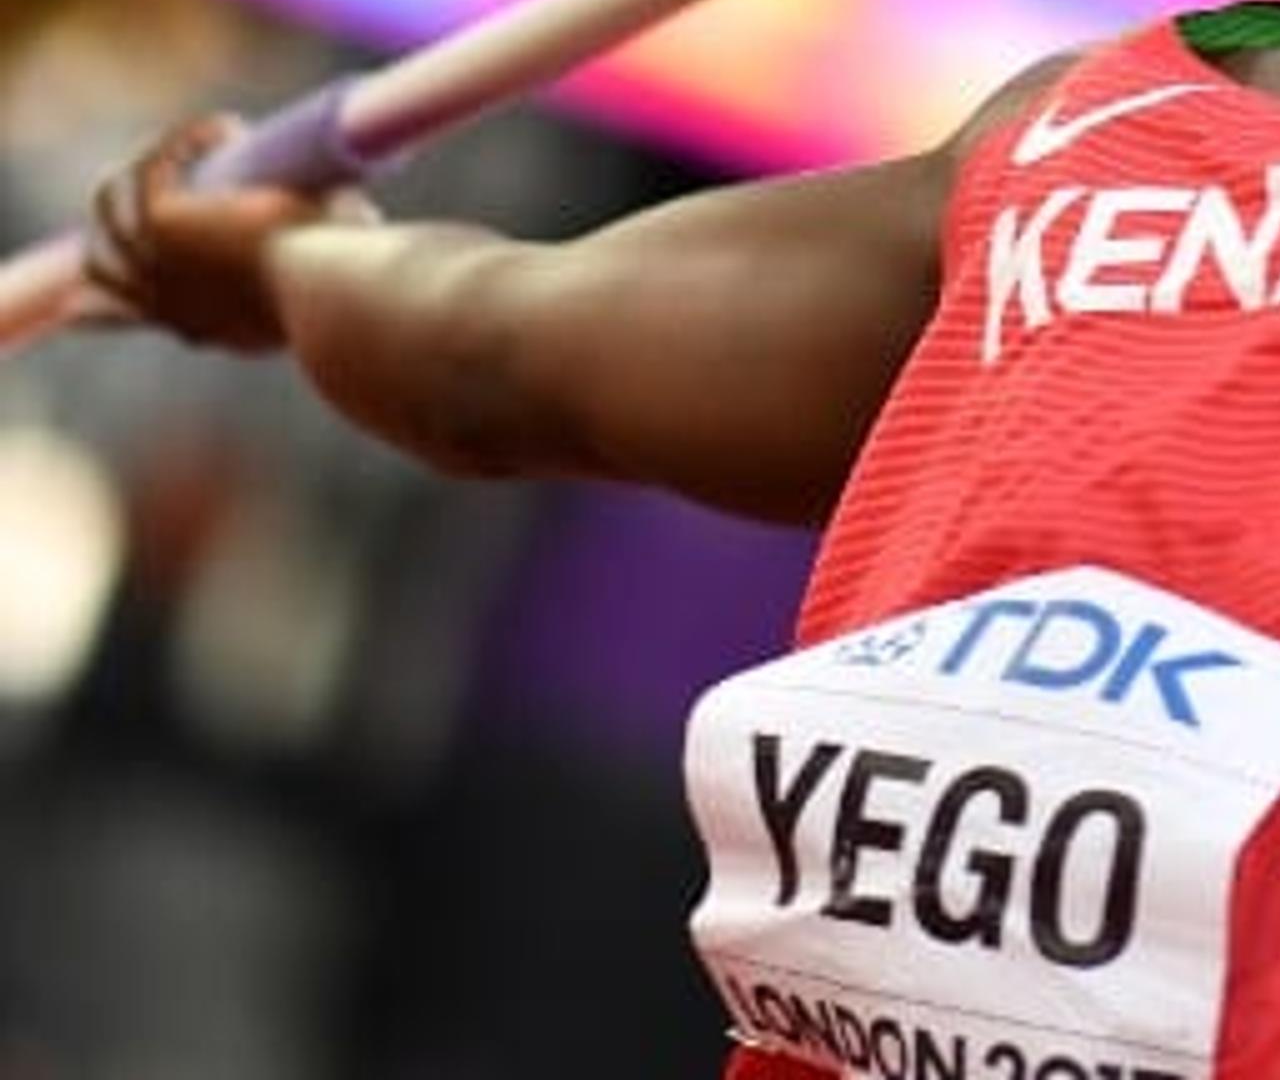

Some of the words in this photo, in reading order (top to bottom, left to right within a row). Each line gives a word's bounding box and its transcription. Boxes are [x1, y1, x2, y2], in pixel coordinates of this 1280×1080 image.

[940, 600, 1241, 726] TDK
[752, 734, 1147, 969] YEGO
[727, 976, 966, 1080] LONDON
